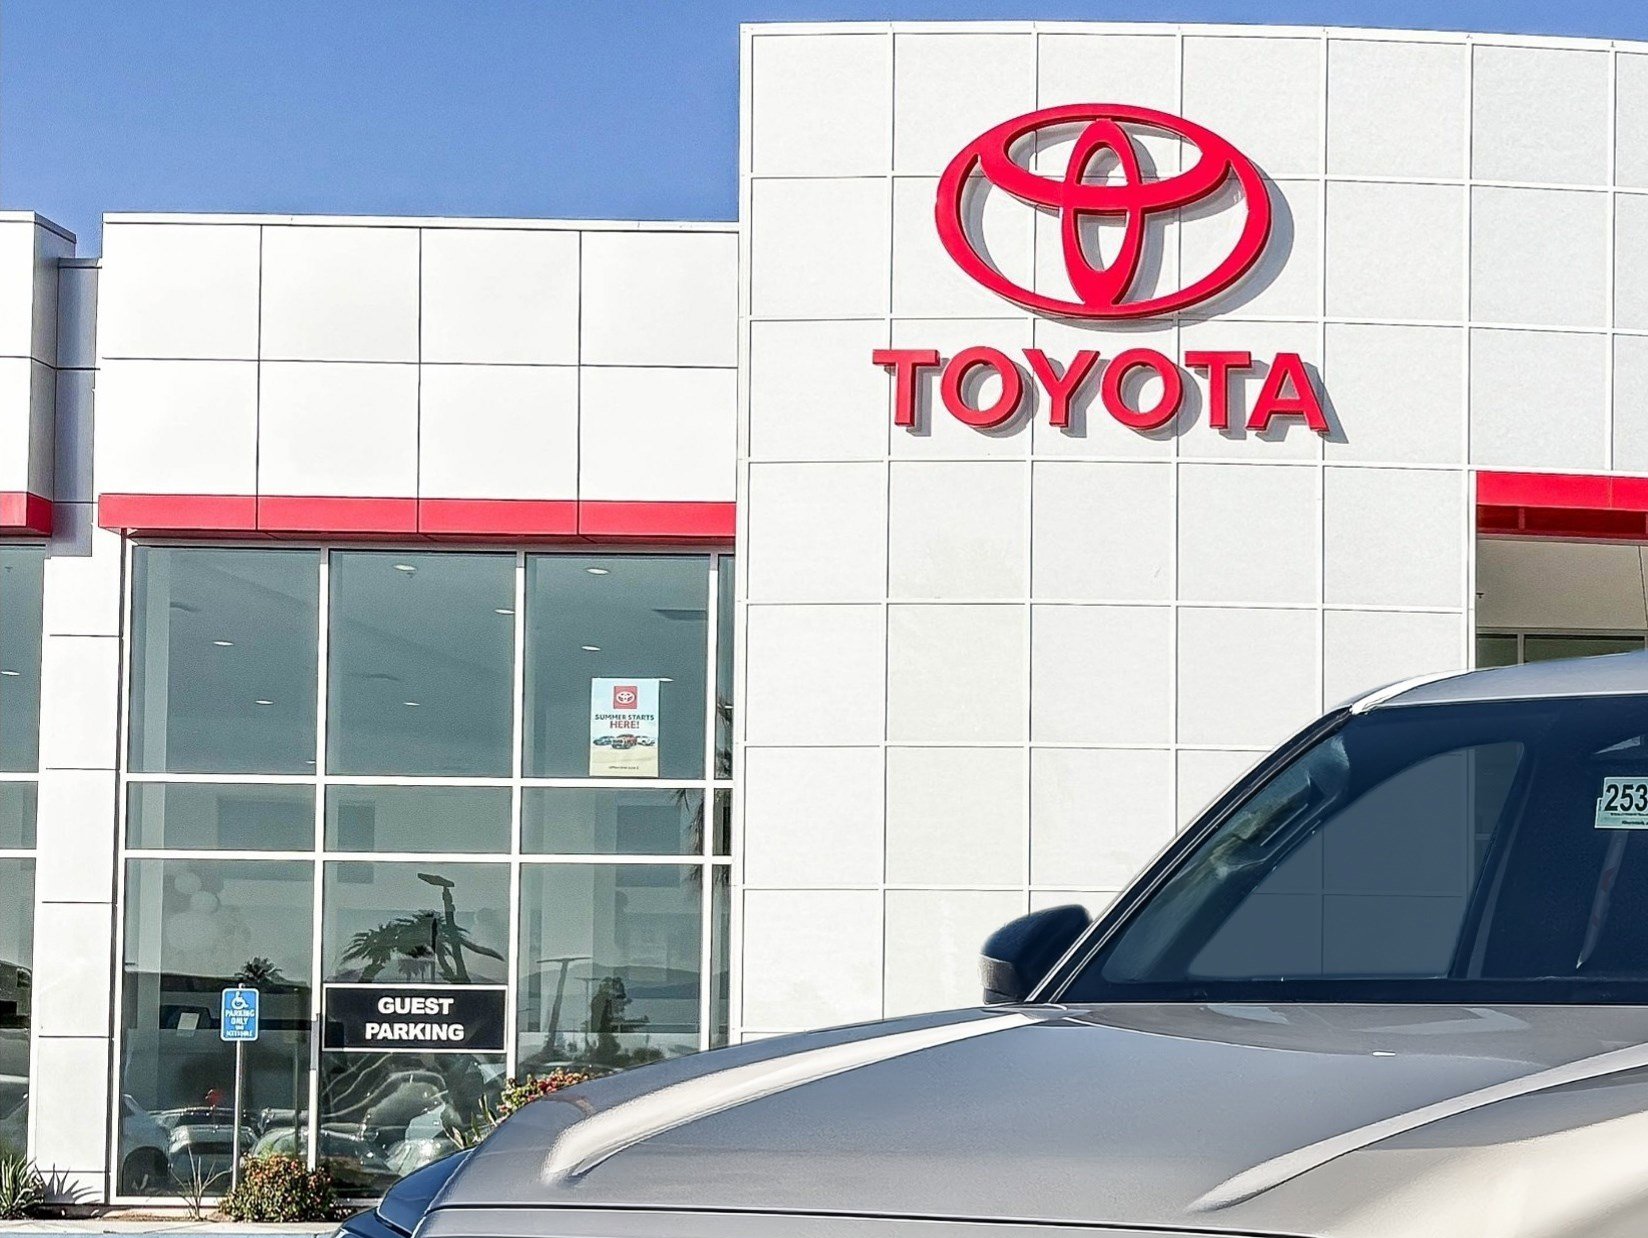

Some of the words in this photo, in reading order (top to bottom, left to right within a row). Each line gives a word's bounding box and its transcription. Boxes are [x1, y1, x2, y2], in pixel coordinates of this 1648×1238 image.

[872, 346, 1330, 434] TOYOTA
[610, 720, 640, 729] HERE!
[377, 997, 455, 1015] GUEST
[365, 1022, 465, 1041] PARKING
